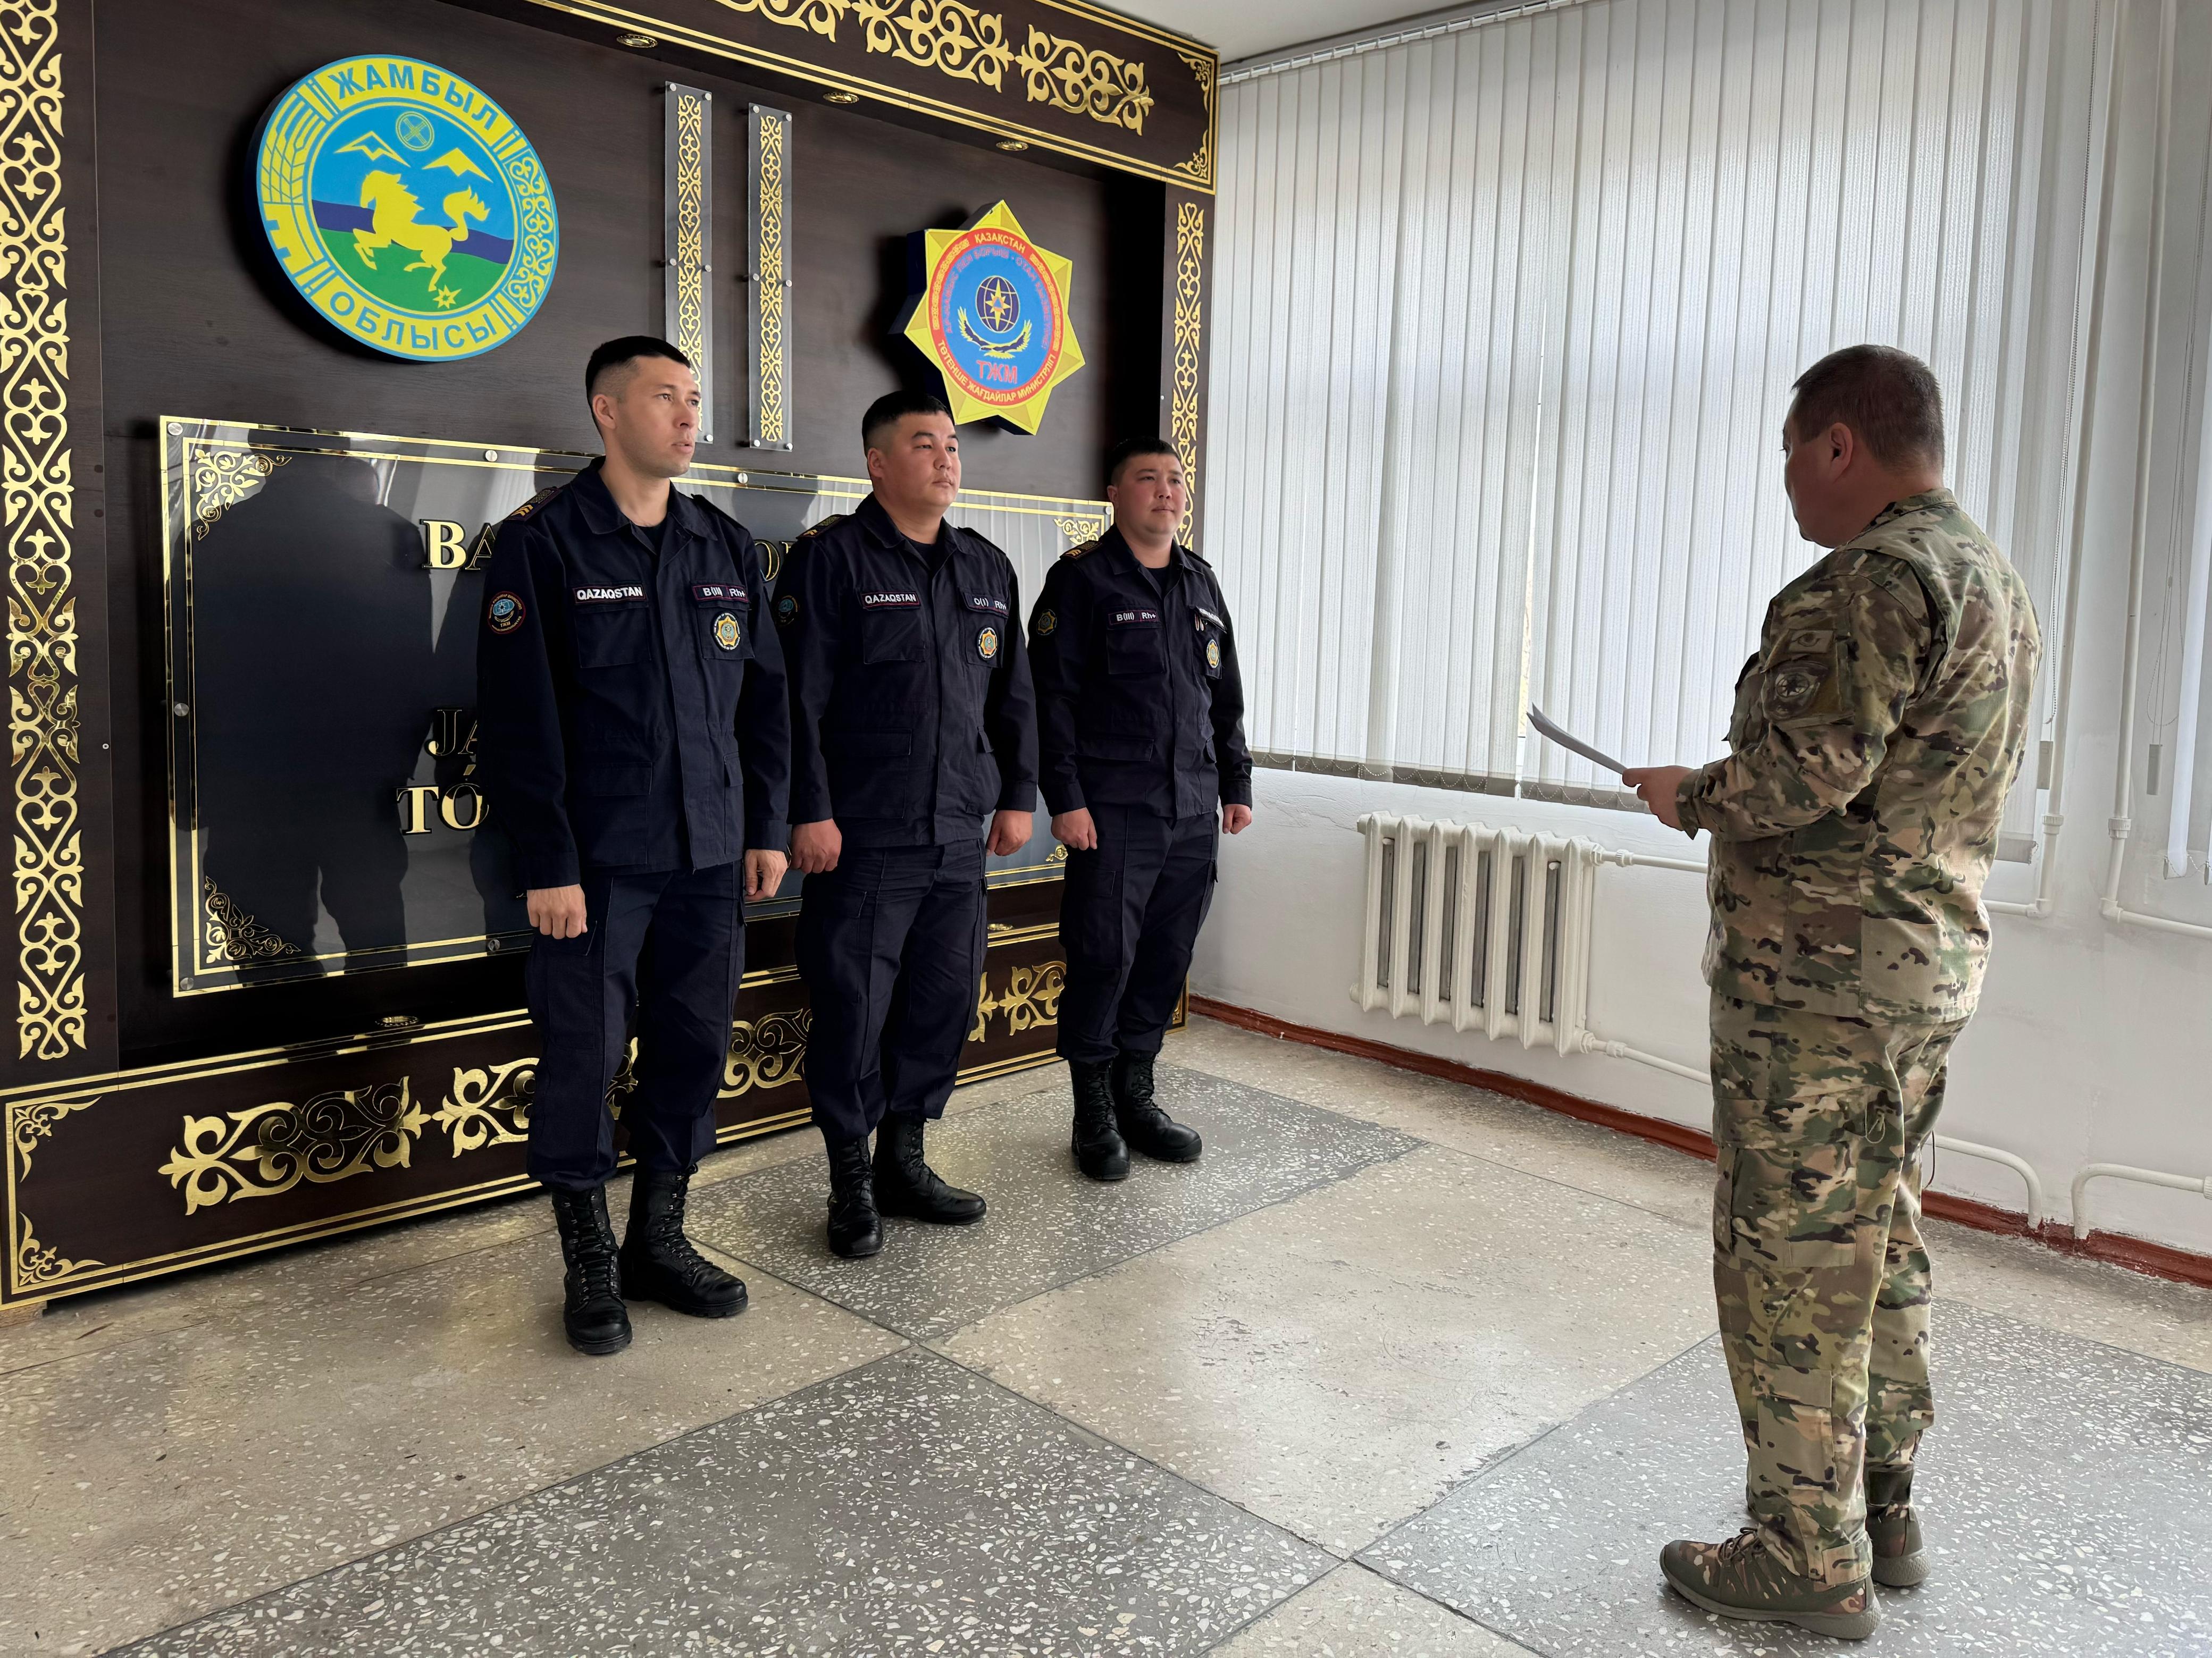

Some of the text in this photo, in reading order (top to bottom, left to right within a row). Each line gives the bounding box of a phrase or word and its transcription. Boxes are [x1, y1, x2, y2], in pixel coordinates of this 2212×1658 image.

[328, 63, 500, 131] ЖАМБЫЛ
[974, 232, 1026, 254] ҚАЗАҚСТАН
[329, 291, 496, 350] ОБЛЫСЫ
[938, 339, 969, 386] ТӨТЕНШЕ
[976, 360, 1018, 384] ТЖМ
[420, 519, 496, 570] BA
[576, 587, 643, 600] QAZAQSTAN
[865, 594, 917, 604] QAZAQSTAN
[397, 764, 489, 834] TÓ
